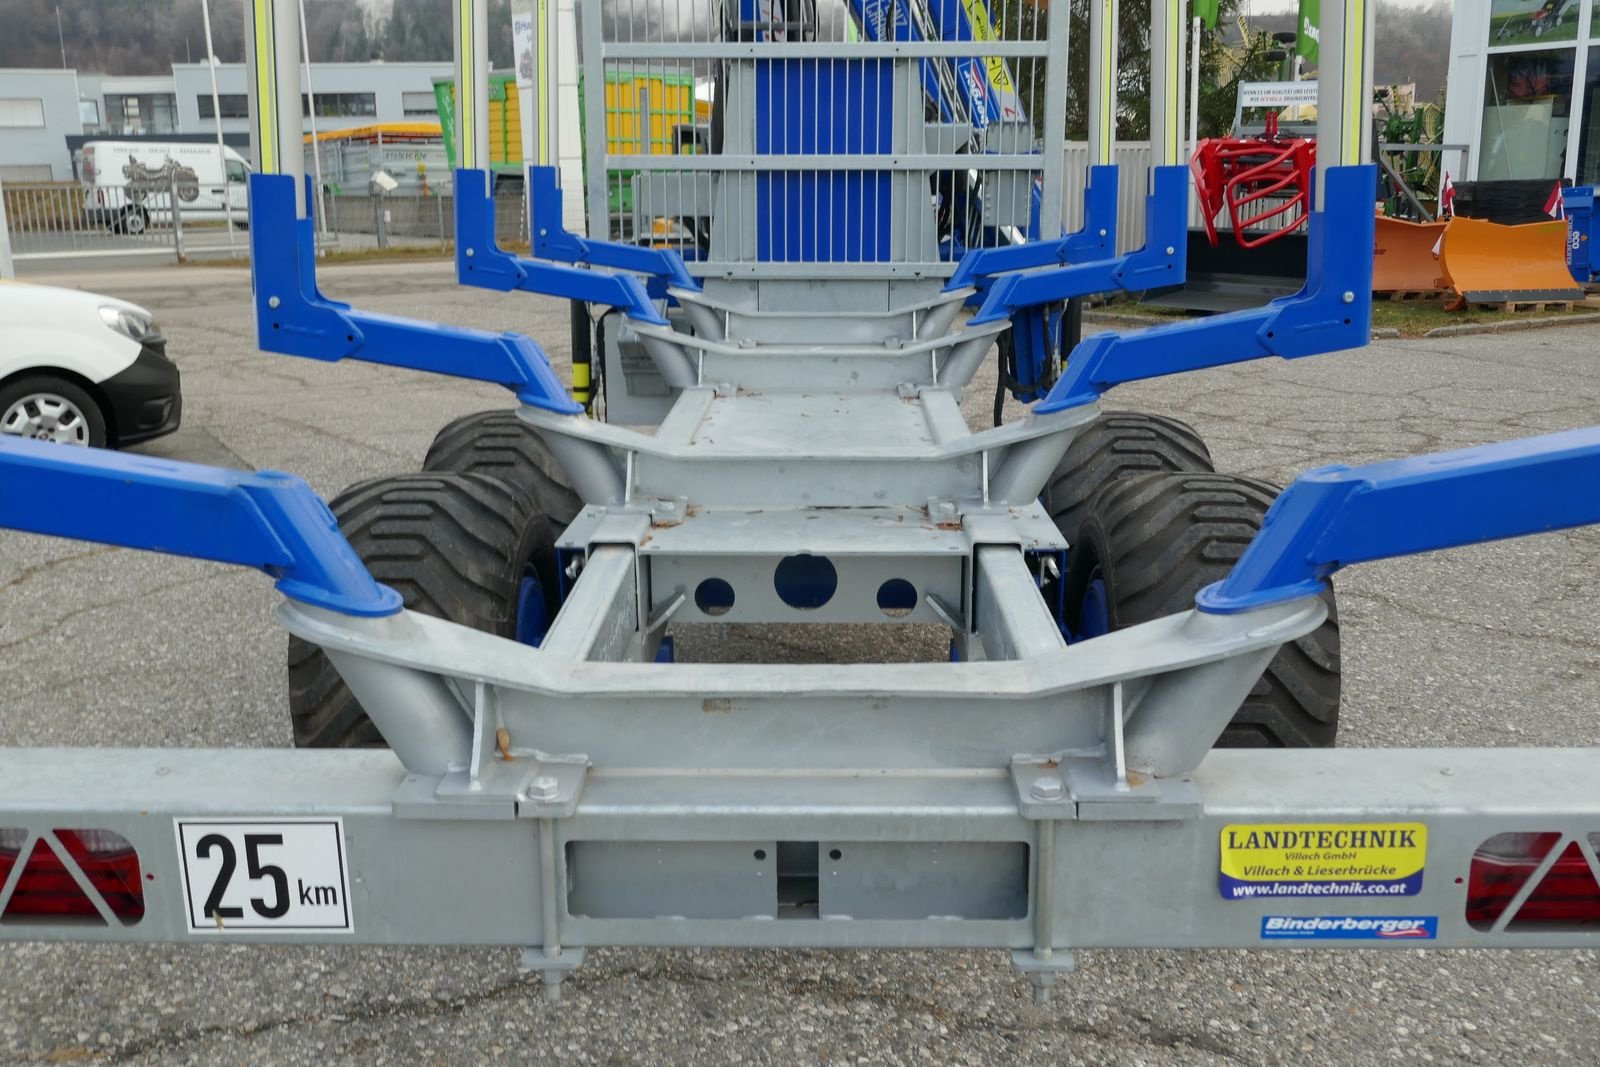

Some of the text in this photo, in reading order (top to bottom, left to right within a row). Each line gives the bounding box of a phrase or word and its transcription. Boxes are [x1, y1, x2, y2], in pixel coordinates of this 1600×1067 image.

[1572, 231, 1580, 249] eco
[1228, 829, 1417, 850] LANDTECHNIK
[1285, 851, 1357, 861] Villach GmbH
[195, 833, 338, 919] 25 km
[1243, 864, 1397, 876] Villach & Lieserbrücke
[1232, 882, 1407, 897] www.landtechnik.co.at
[1265, 917, 1425, 931] Binderberger
